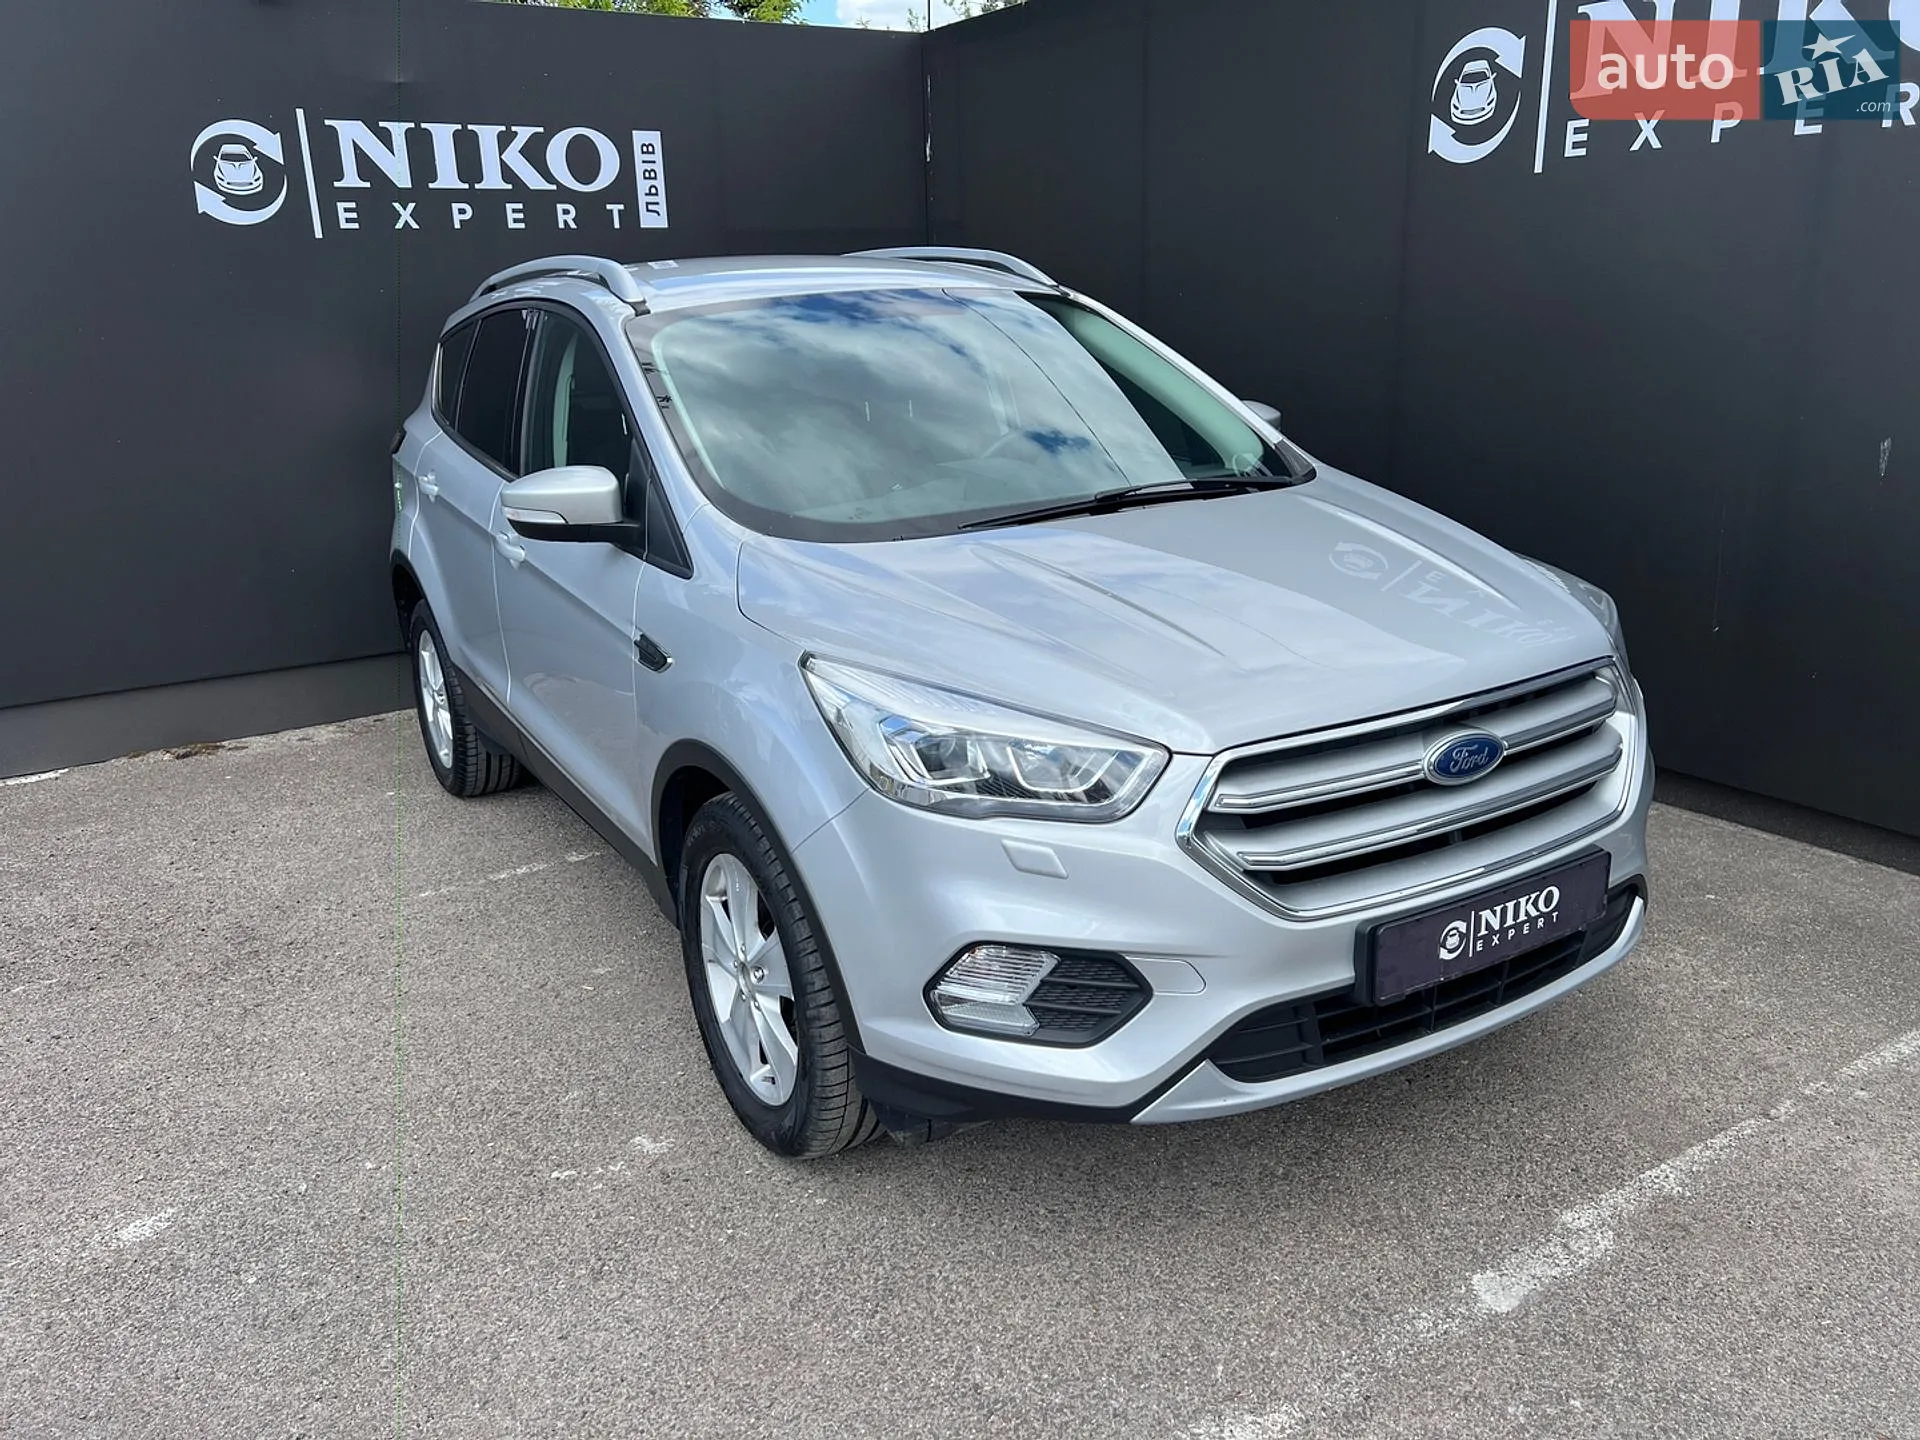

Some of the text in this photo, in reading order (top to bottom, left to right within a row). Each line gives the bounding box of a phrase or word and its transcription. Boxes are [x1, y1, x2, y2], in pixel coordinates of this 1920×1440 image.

[323, 118, 621, 193] NIKO
[640, 141, 663, 218] ЛЬВІВ
[336, 201, 625, 231] EXPERT
[1450, 743, 1489, 773] Ford
[1476, 911, 1560, 952] EXPERT
[1478, 885, 1560, 937] NIKO
